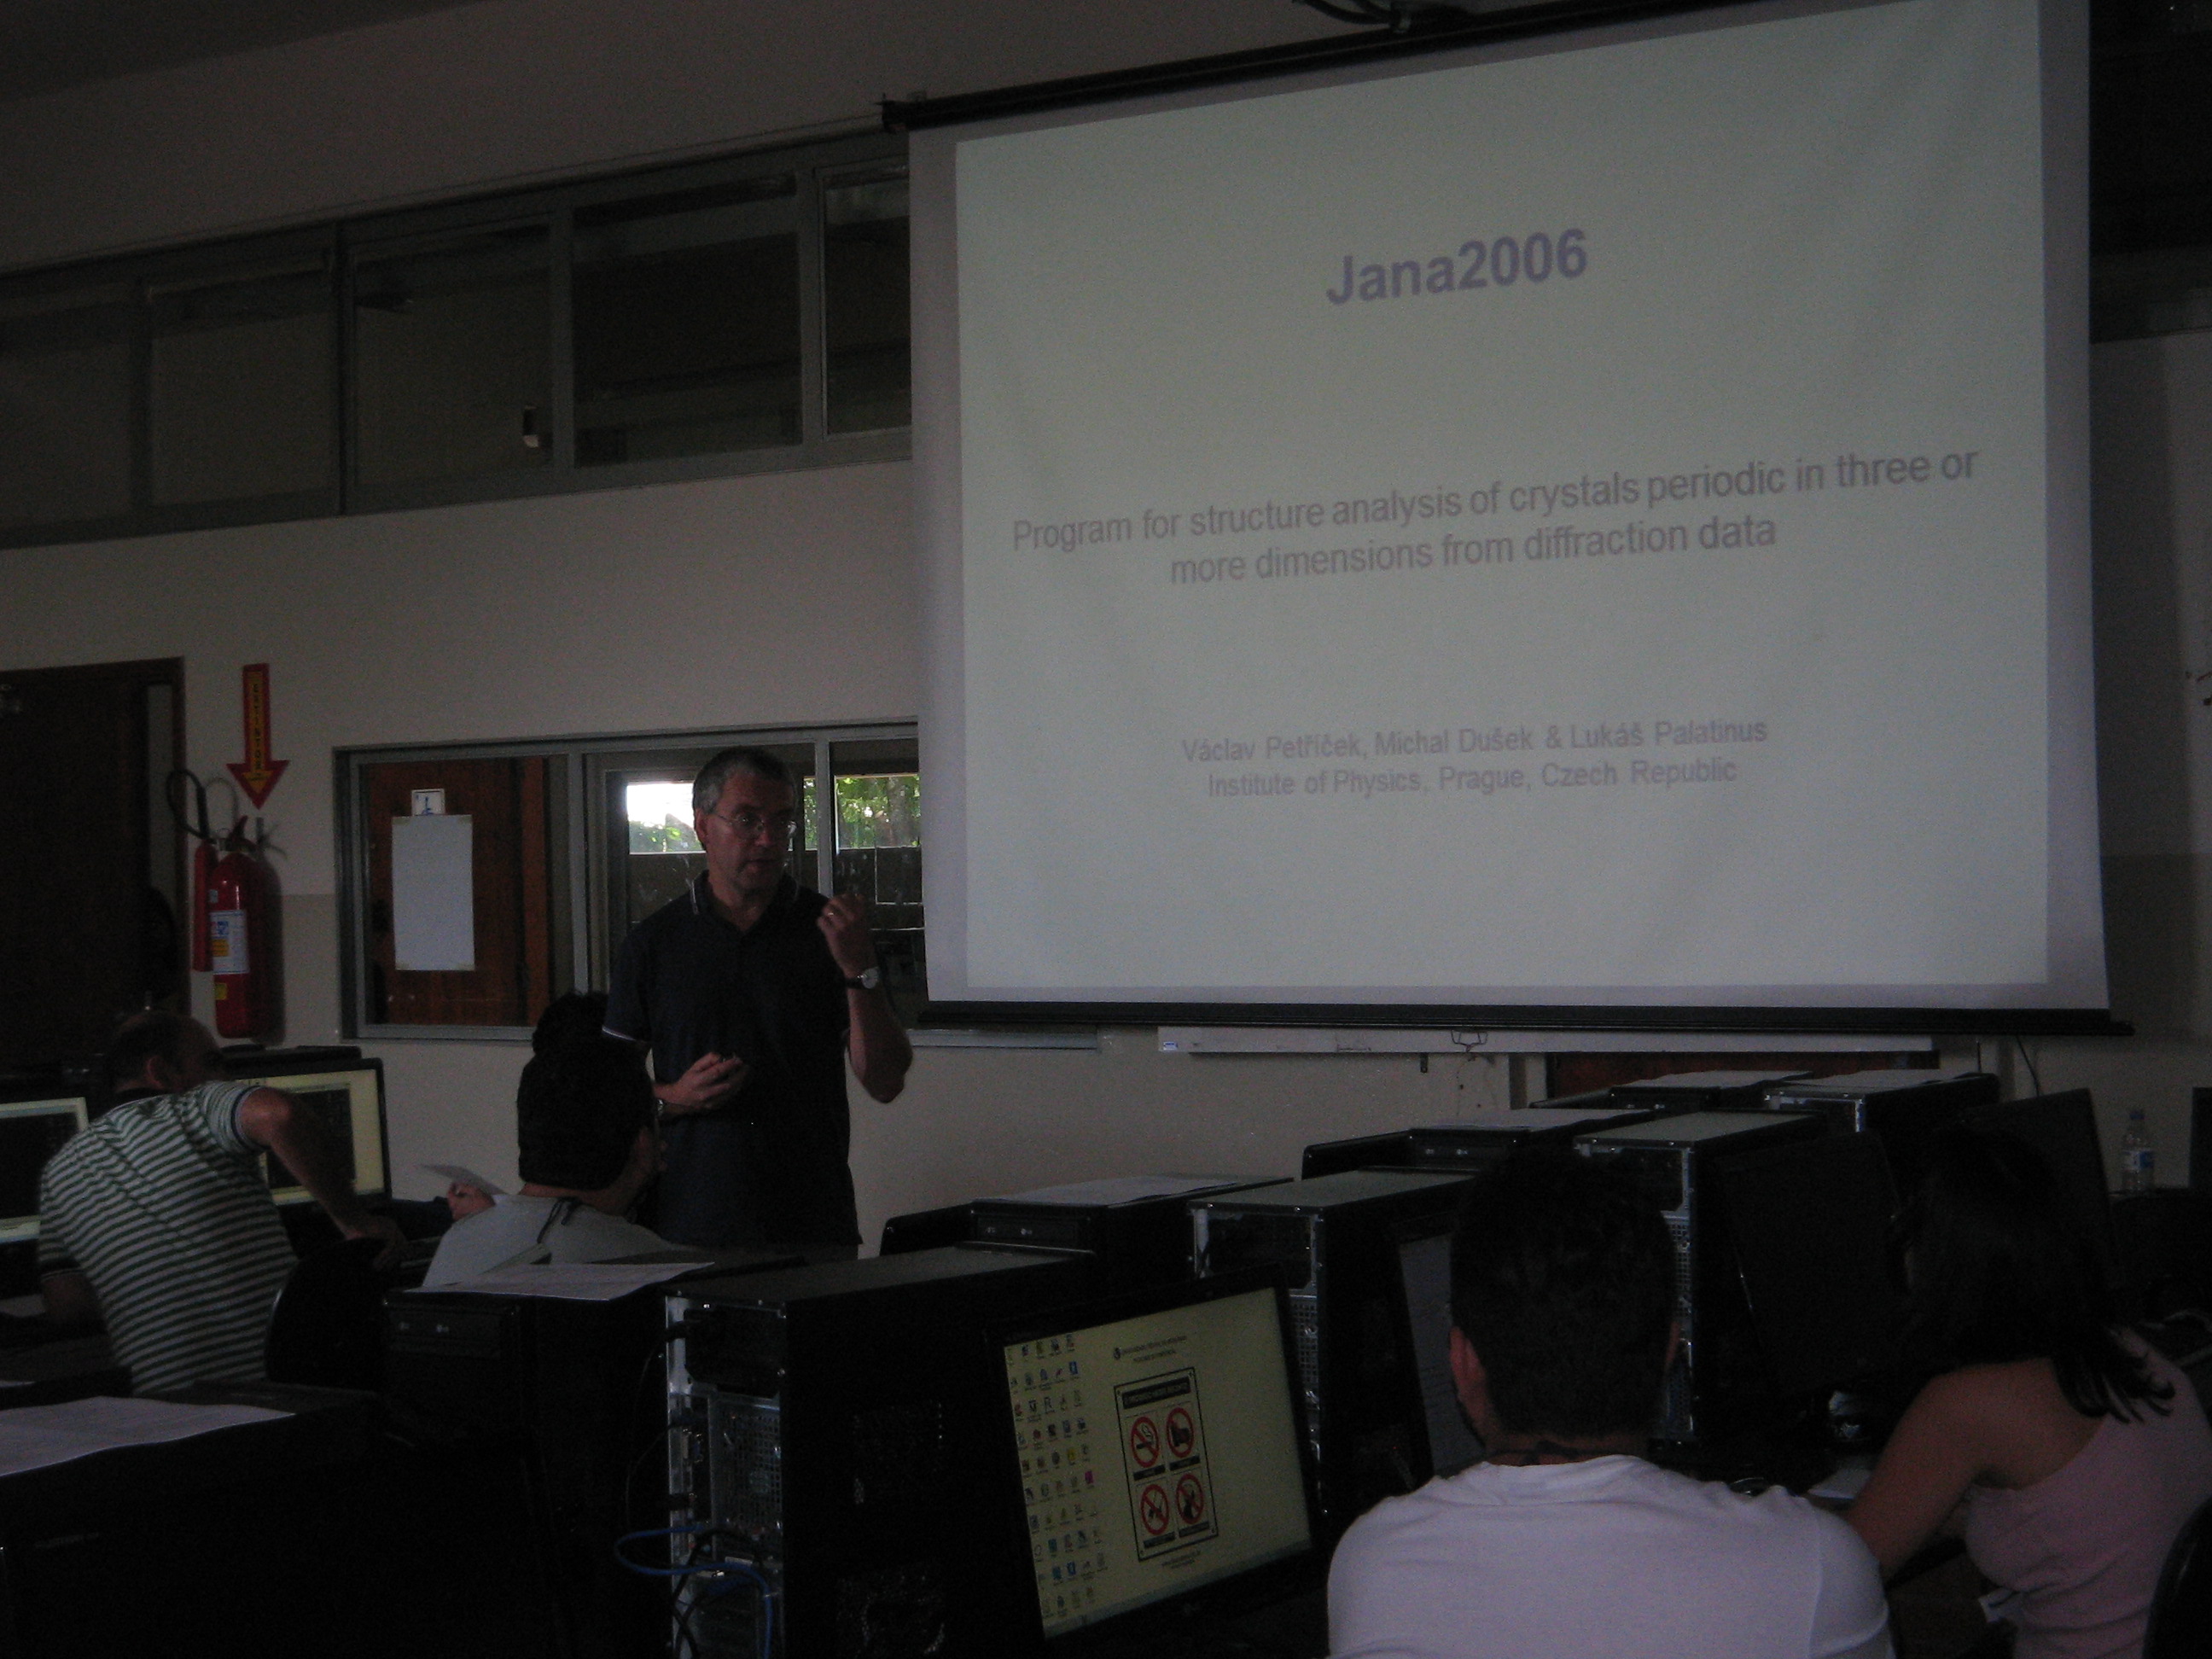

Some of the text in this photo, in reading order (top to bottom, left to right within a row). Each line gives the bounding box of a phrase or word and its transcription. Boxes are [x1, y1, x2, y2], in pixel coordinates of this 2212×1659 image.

[1326, 228, 1587, 304] Jana2006
[1013, 451, 1980, 553] Program for structure analysis of crystals periodic in three or
[1170, 515, 1777, 585] more dimensions from diffraction data
[1374, 729, 1450, 756] Michal
[1545, 725, 1563, 749] &
[1654, 719, 1768, 748] Palatinus
[1208, 773, 1295, 797] Institute
[1303, 770, 1327, 795] of
[1540, 762, 1619, 787] Czech
[1629, 757, 1738, 788] Republic
